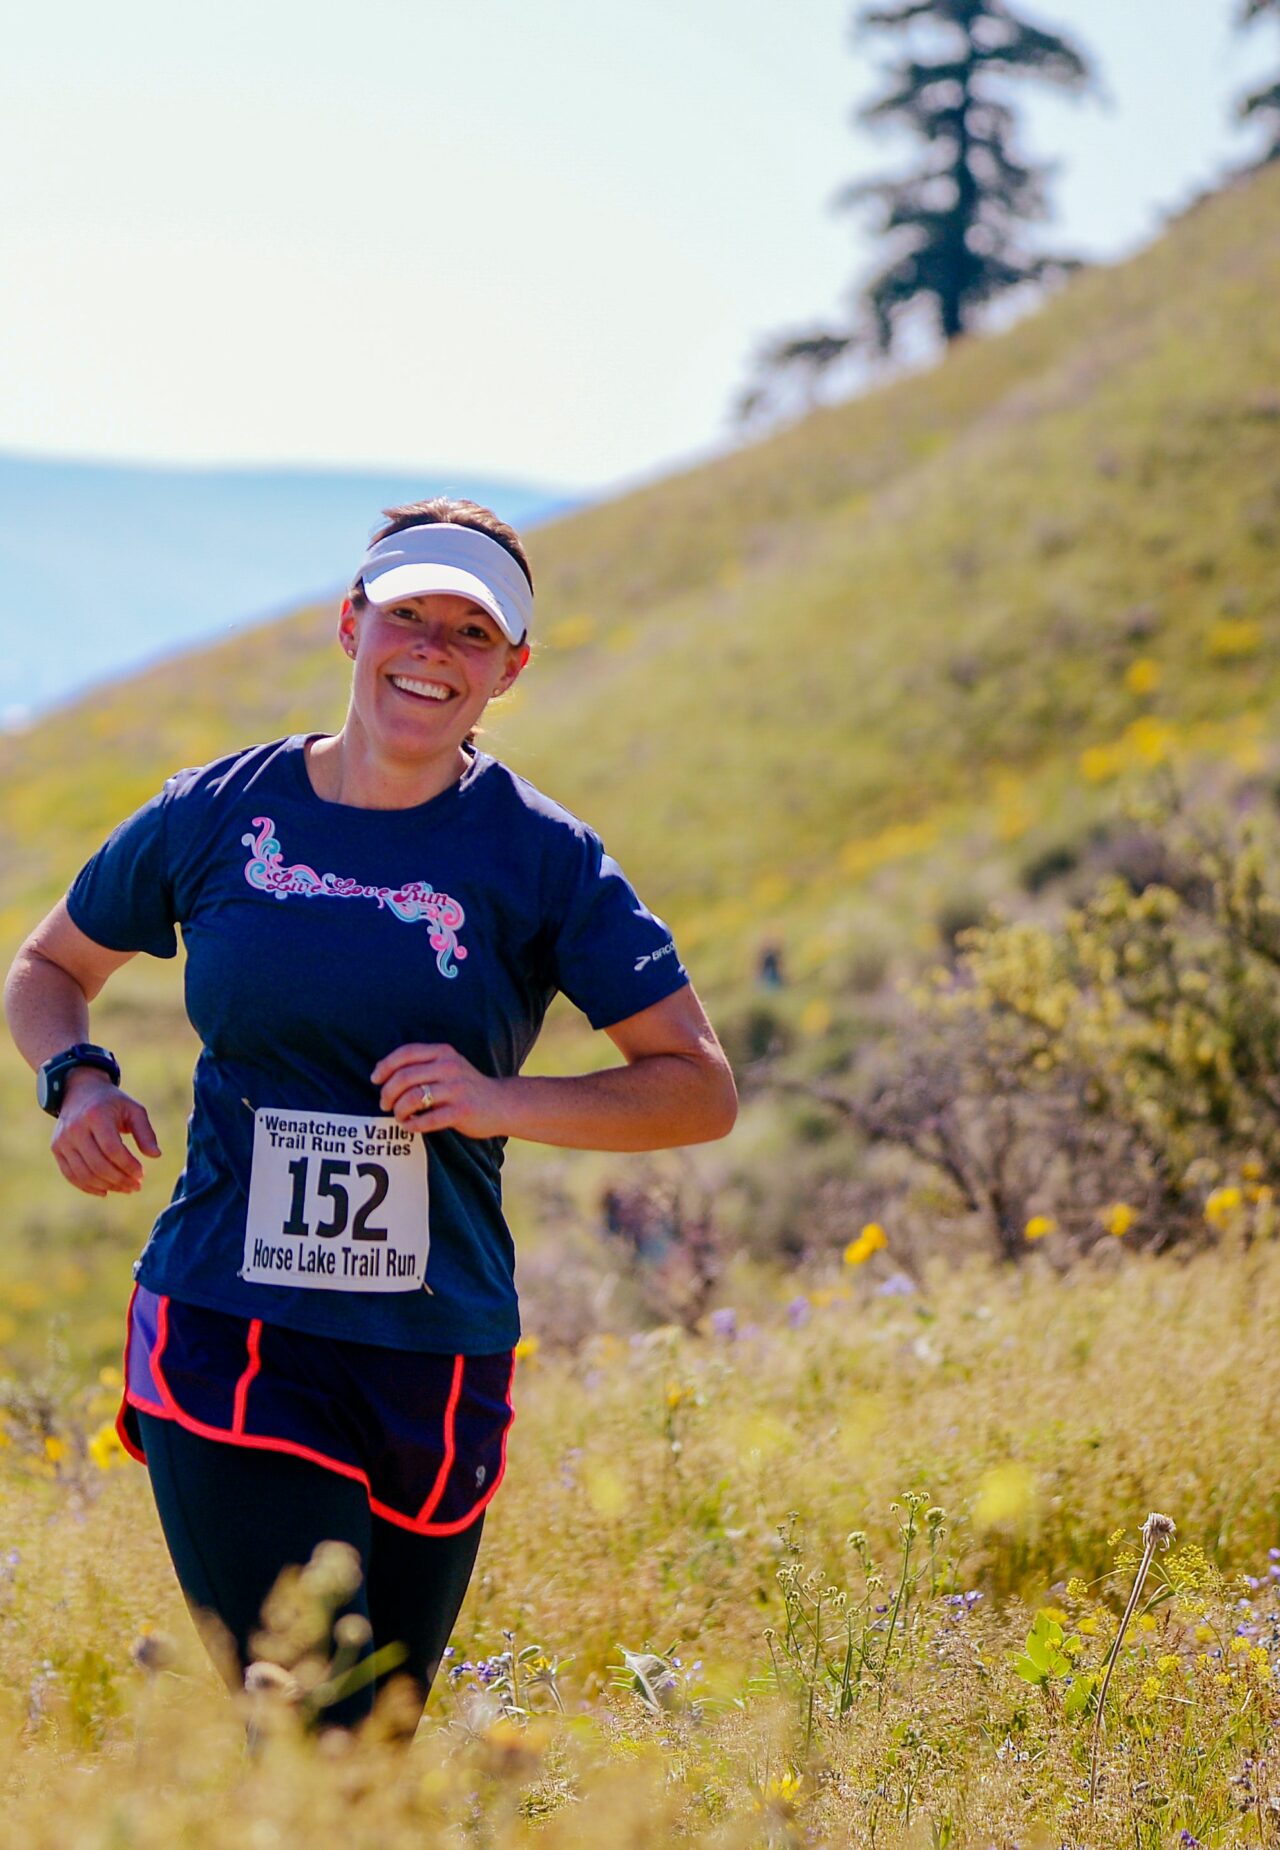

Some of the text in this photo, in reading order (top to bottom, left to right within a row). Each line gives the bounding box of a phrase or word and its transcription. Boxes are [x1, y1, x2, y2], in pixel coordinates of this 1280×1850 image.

[266, 872, 448, 905] Live Love Run
[265, 1115, 415, 1142] Wenatchee Valley
[269, 1132, 411, 1156] Trail Run Series
[282, 1156, 389, 1241] 152
[253, 1238, 416, 1277] Horse Lake Trail Run
